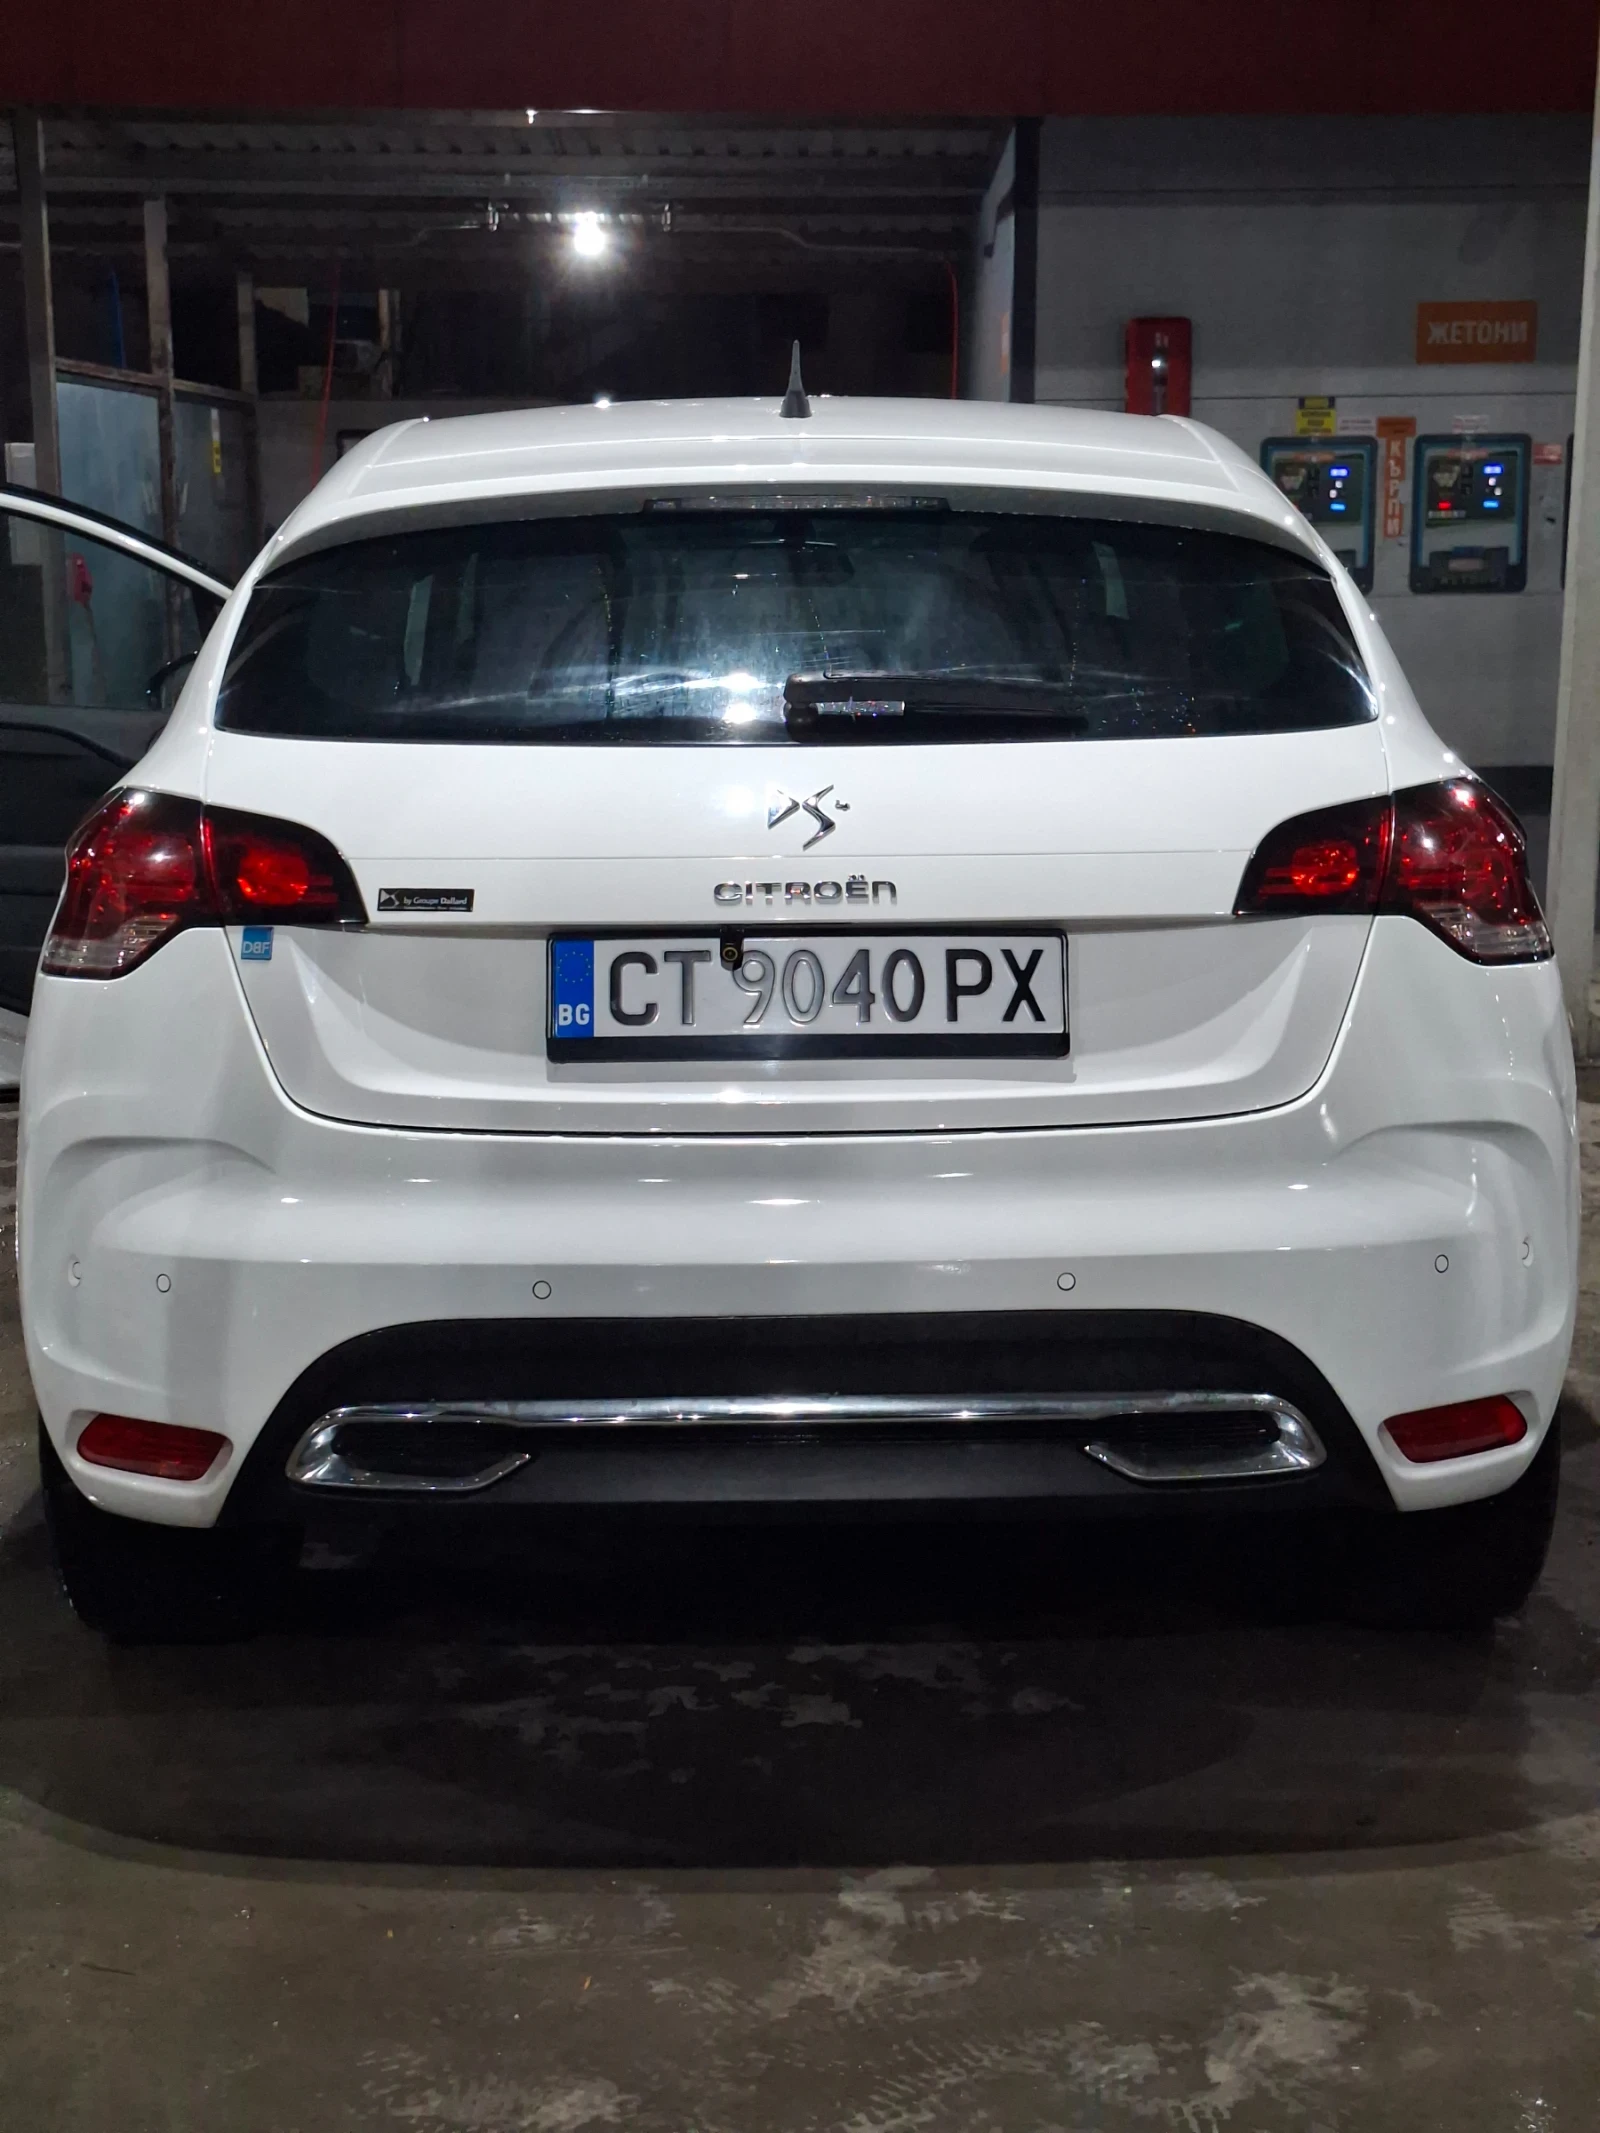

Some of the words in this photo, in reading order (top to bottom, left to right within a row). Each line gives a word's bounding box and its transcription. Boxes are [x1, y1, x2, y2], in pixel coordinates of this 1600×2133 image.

[1428, 320, 1527, 344] ЖЕТОНИ
[1387, 440, 1402, 536] КЪРПИ
[403, 897, 412, 905] by
[609, 949, 711, 1027] CT
[732, 949, 925, 1026] 9040
[945, 948, 1046, 1023] PX
[557, 1003, 590, 1025] BG
